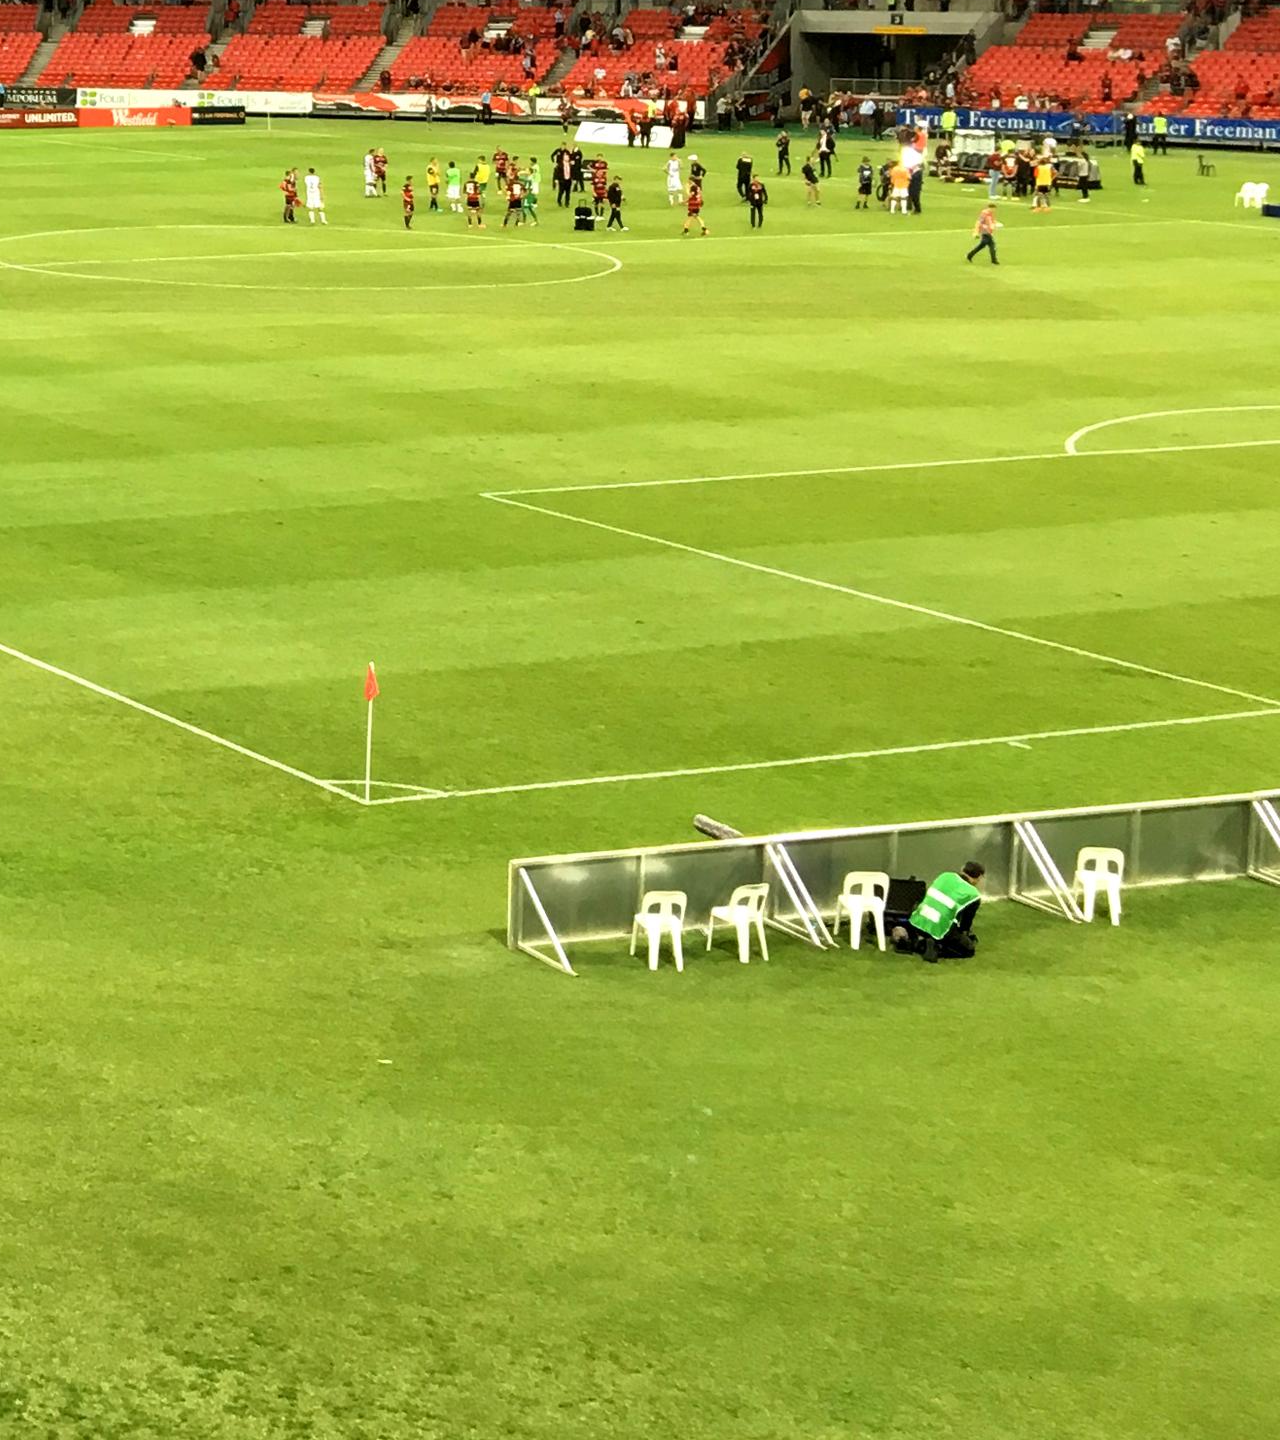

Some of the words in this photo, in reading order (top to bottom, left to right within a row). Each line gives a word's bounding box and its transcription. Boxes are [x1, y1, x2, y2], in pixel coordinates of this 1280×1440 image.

[6, 94, 58, 104] MPORIUM
[24, 112, 78, 123] UNLIMITED.
[111, 108, 159, 126] Westfield
[969, 110, 1047, 130] Freeman
[1194, 118, 1276, 139] Freeman
